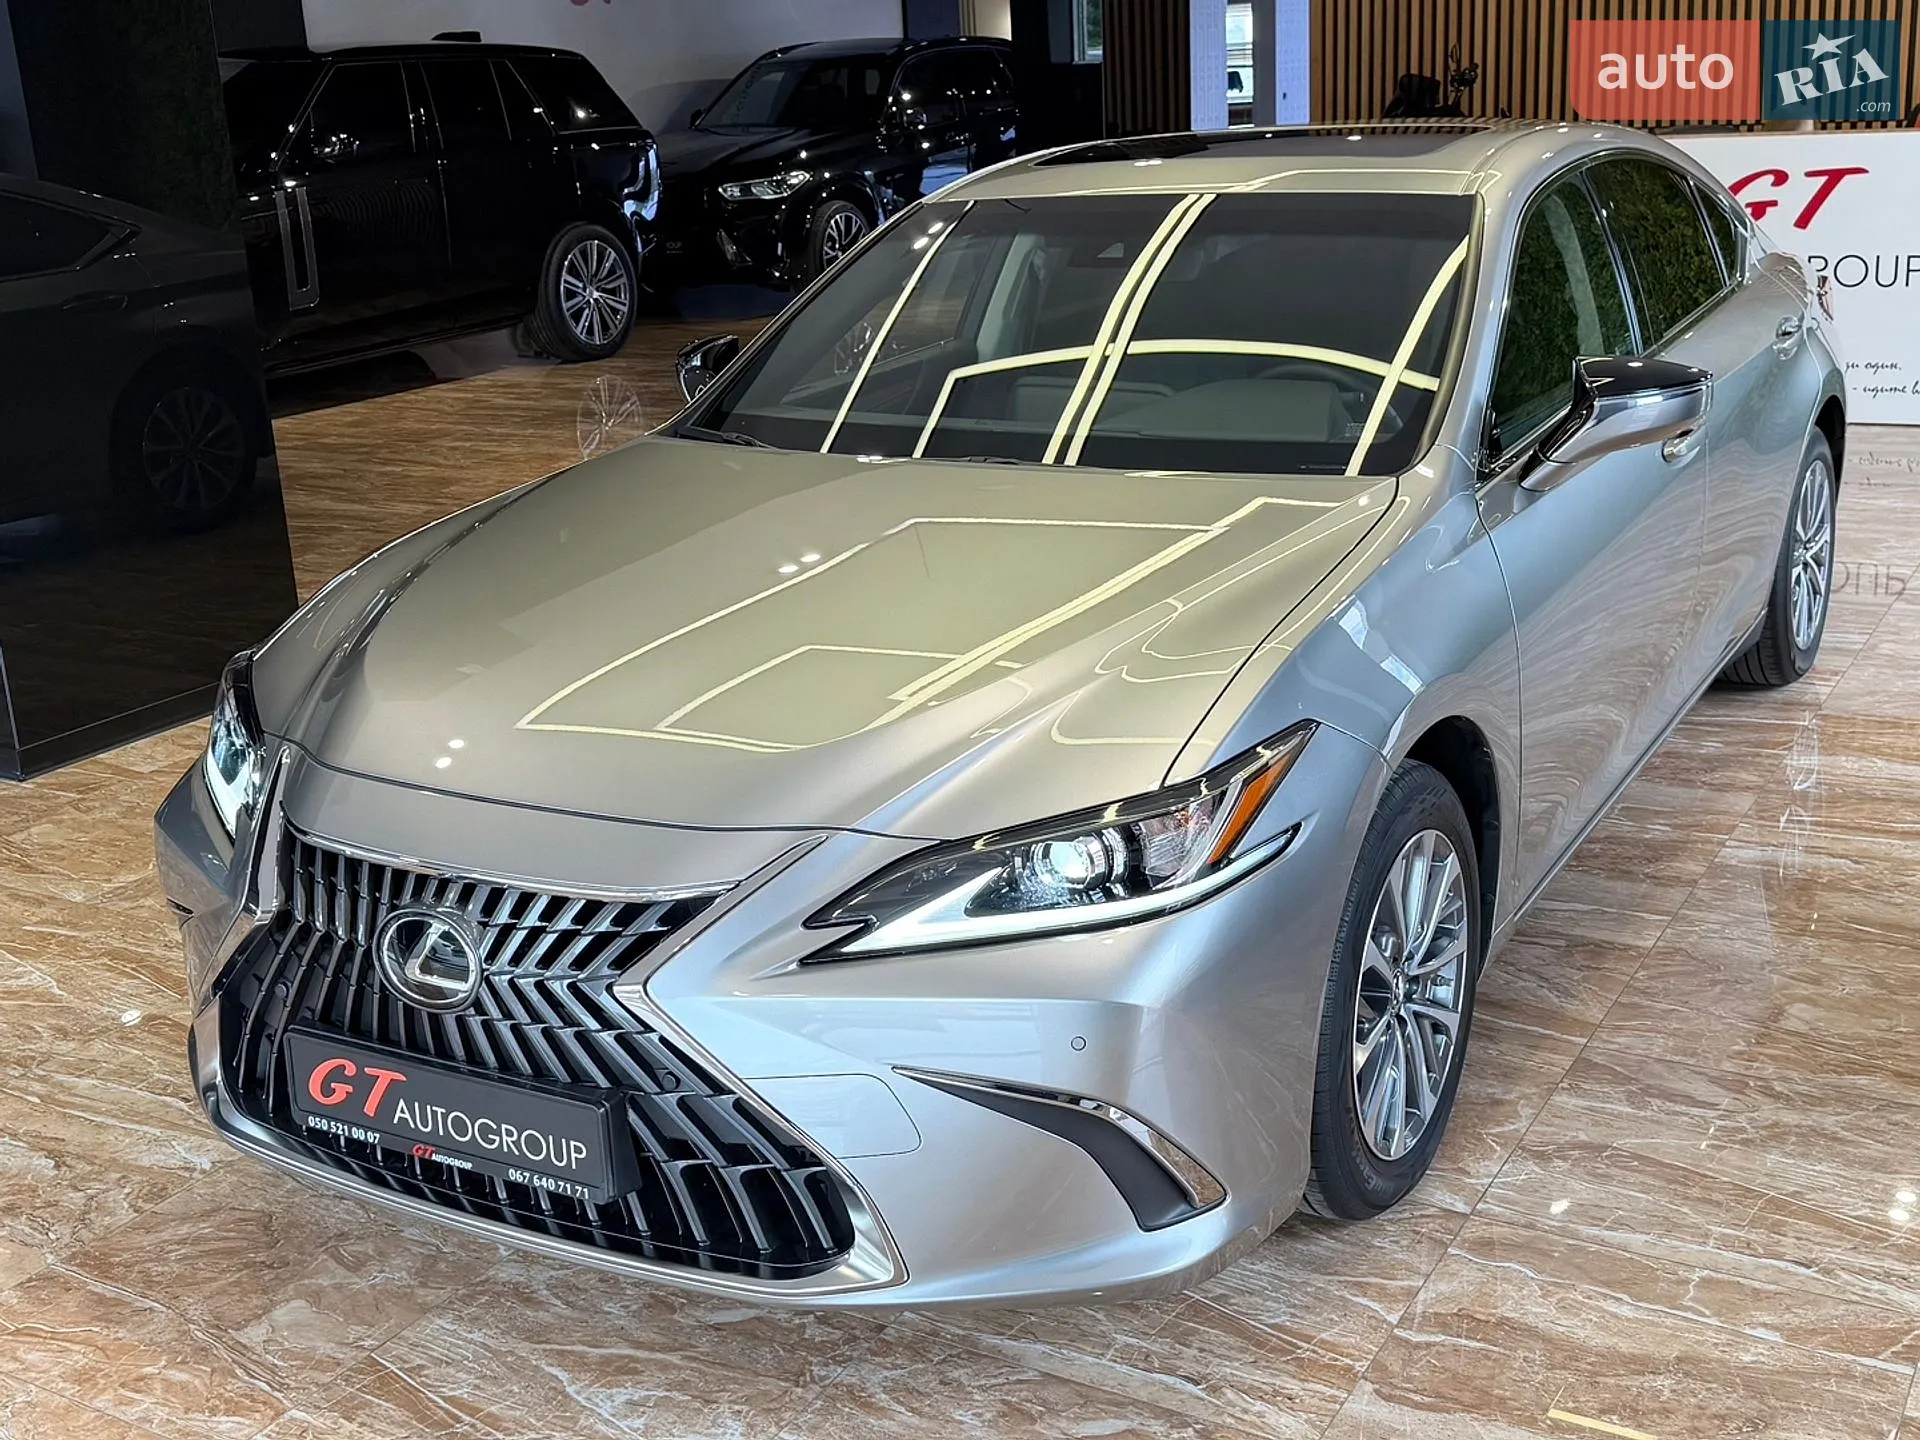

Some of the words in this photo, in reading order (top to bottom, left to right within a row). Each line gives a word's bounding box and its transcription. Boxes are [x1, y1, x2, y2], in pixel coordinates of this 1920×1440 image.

[1728, 167, 1870, 230] GT
[308, 1058, 408, 1118] GT
[393, 1098, 587, 1170] AUTOGROUP
[308, 1115, 328, 1131] 050
[330, 1121, 349, 1137] 521
[351, 1126, 365, 1141] 00
[367, 1131, 380, 1144] 07
[508, 1168, 531, 1184] 067
[533, 1174, 555, 1191] 640
[557, 1181, 571, 1195] 71
[574, 1185, 589, 1200] 71
